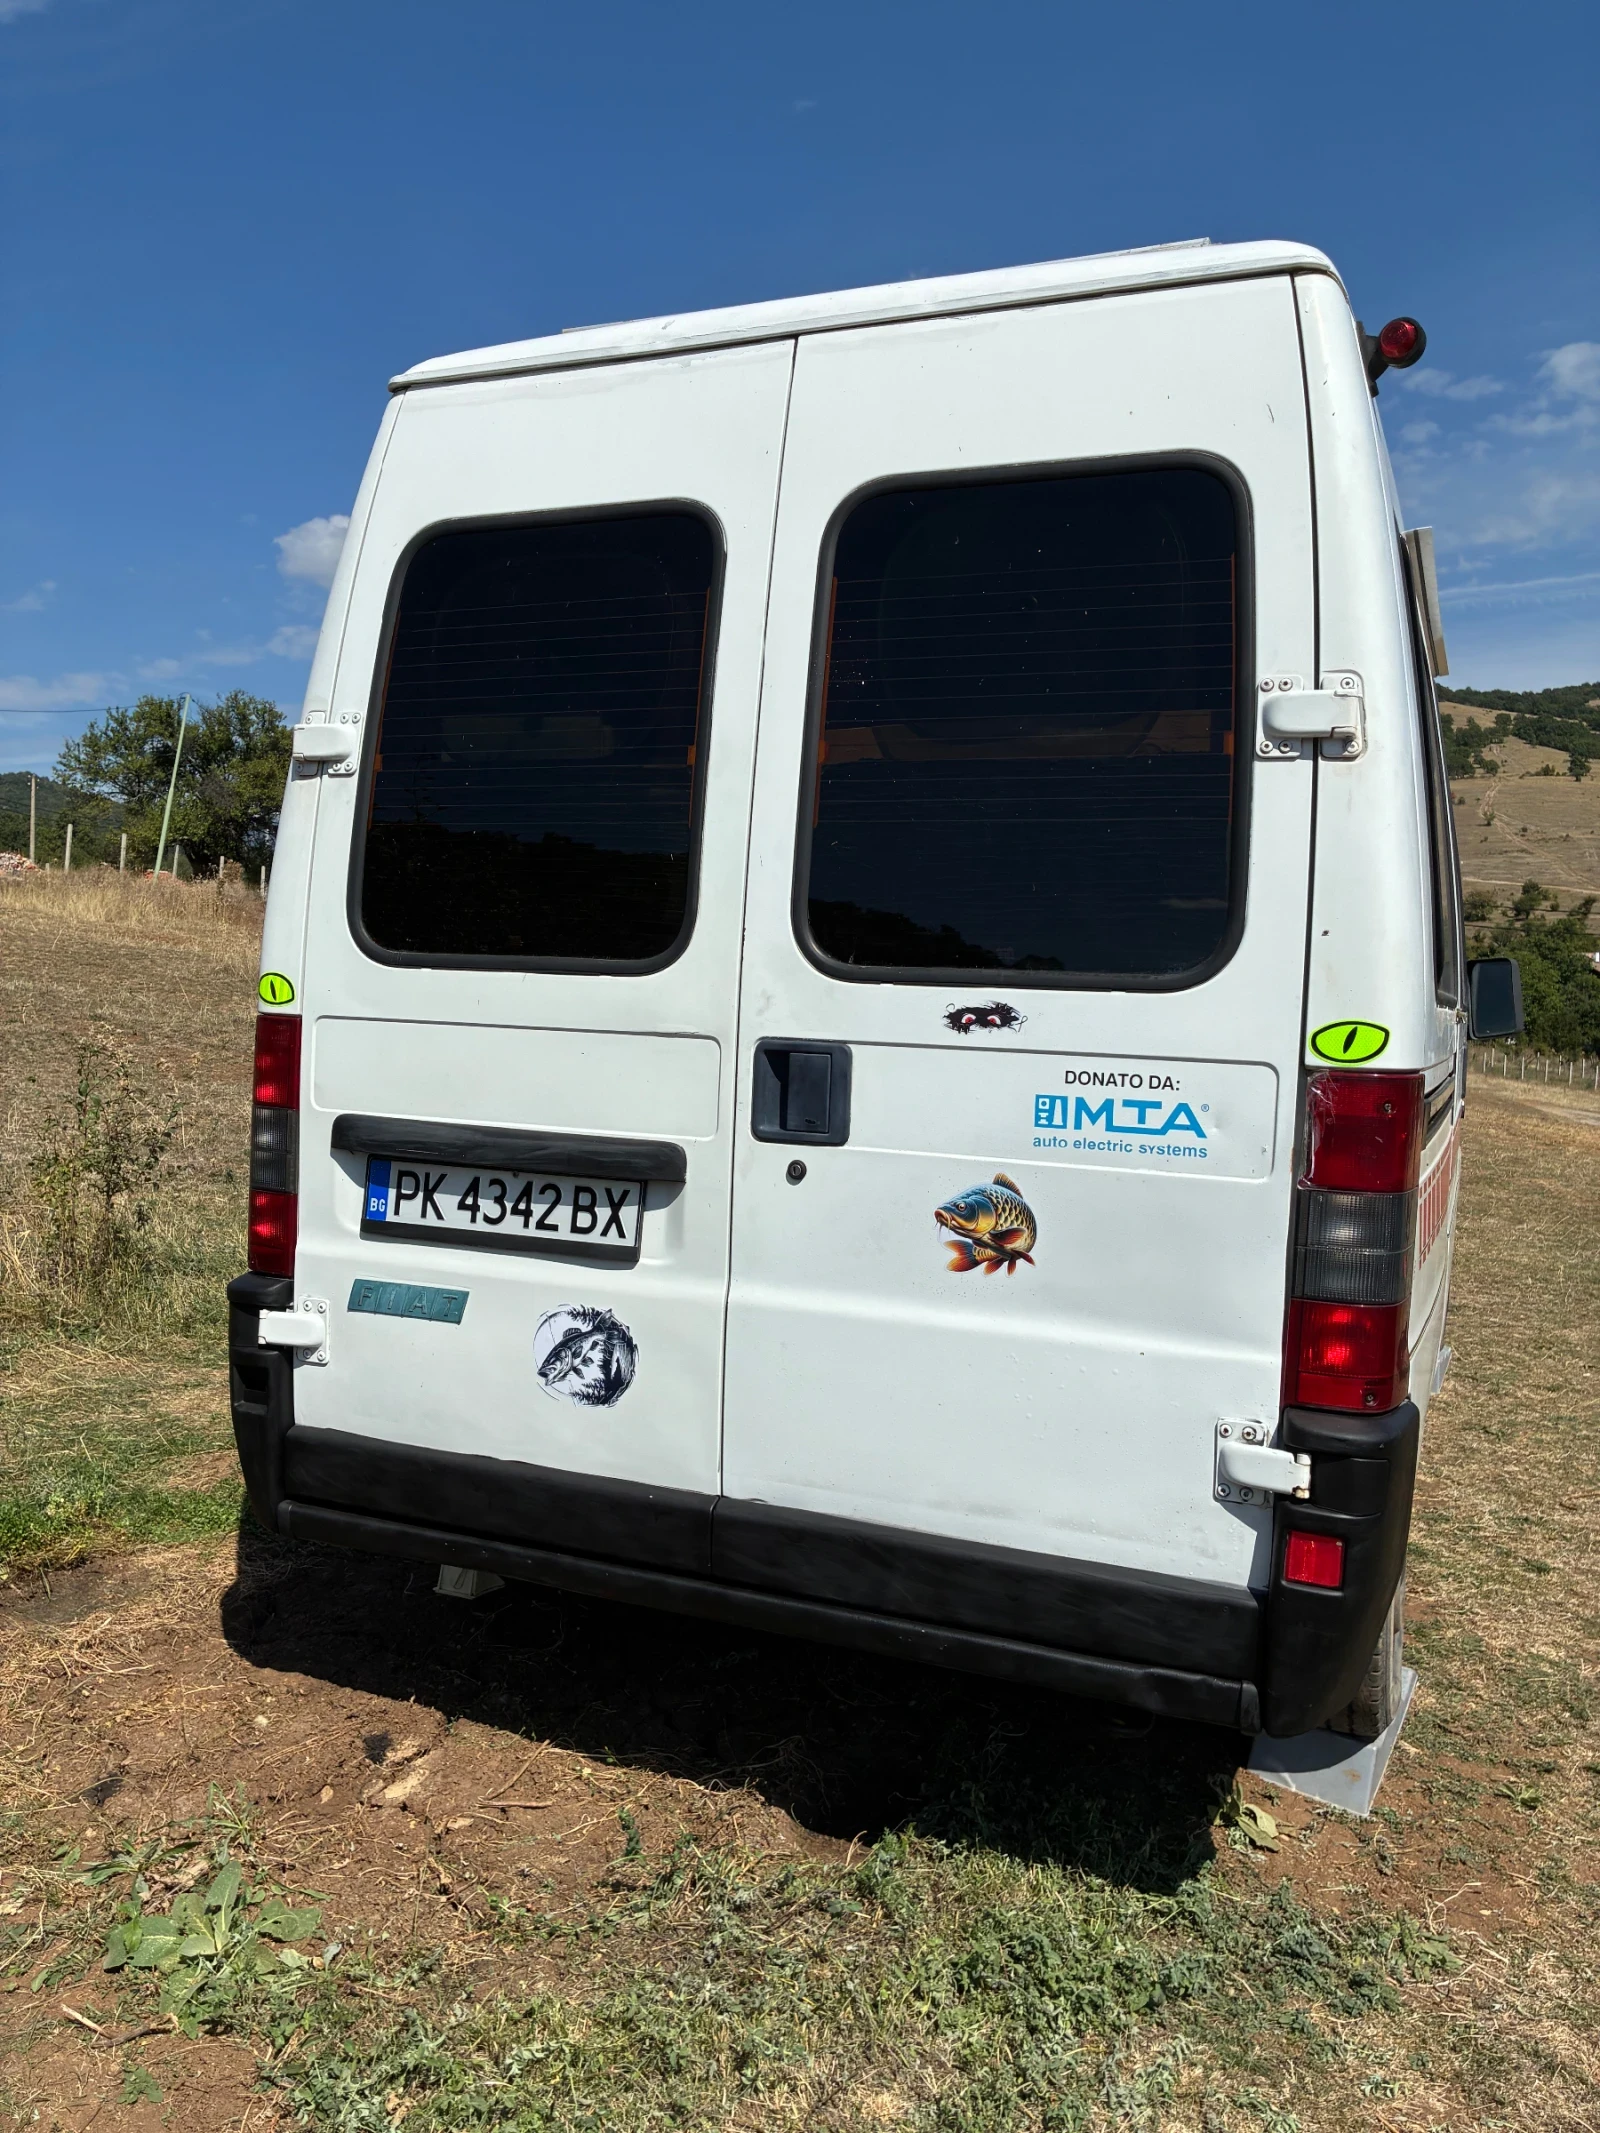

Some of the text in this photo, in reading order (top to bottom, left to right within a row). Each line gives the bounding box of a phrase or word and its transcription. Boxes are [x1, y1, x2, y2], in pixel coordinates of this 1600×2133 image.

[1064, 1070, 1181, 1091] DONATO DA:
[1032, 1136, 1208, 1159] auto electric systems
[369, 1197, 387, 1213] BG
[393, 1169, 631, 1239] PK 4342 BX
[357, 1284, 459, 1317] FIAT
